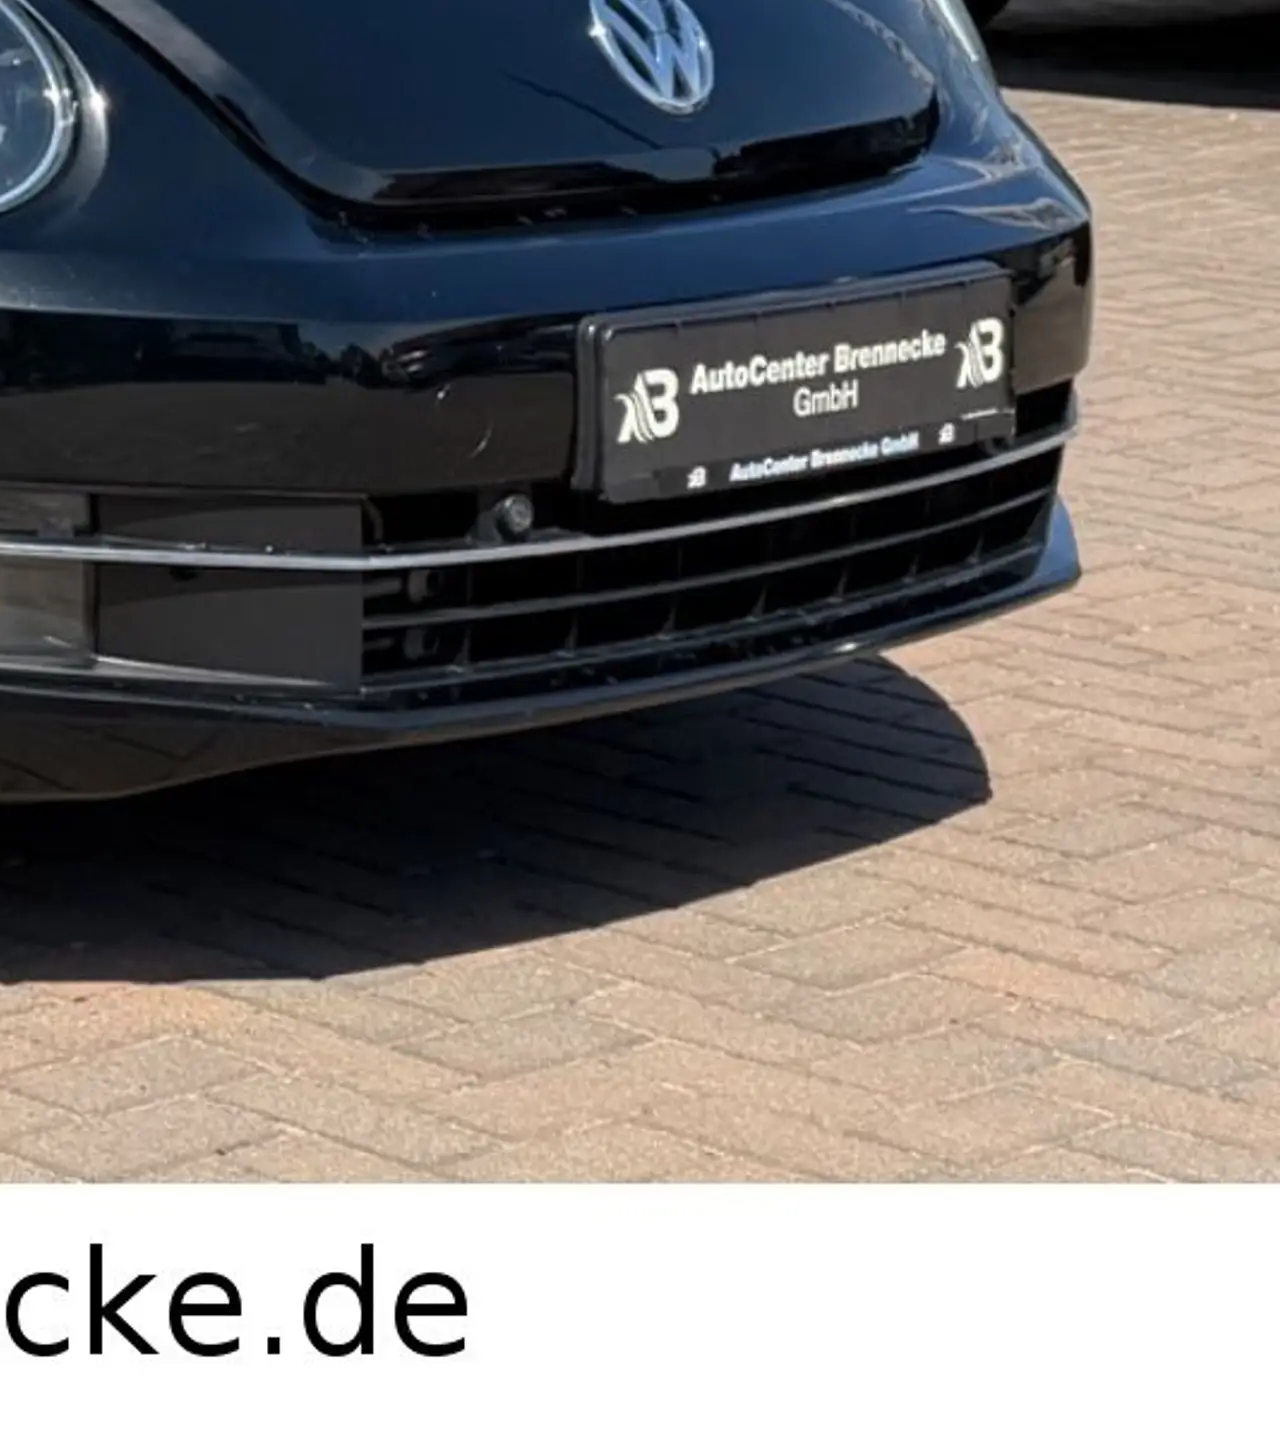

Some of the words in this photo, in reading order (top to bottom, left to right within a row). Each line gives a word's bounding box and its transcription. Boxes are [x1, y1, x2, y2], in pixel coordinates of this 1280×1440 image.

[689, 350, 831, 396] AutoCenter
[833, 328, 947, 375] Brennecke
[792, 377, 860, 419] GmbH
